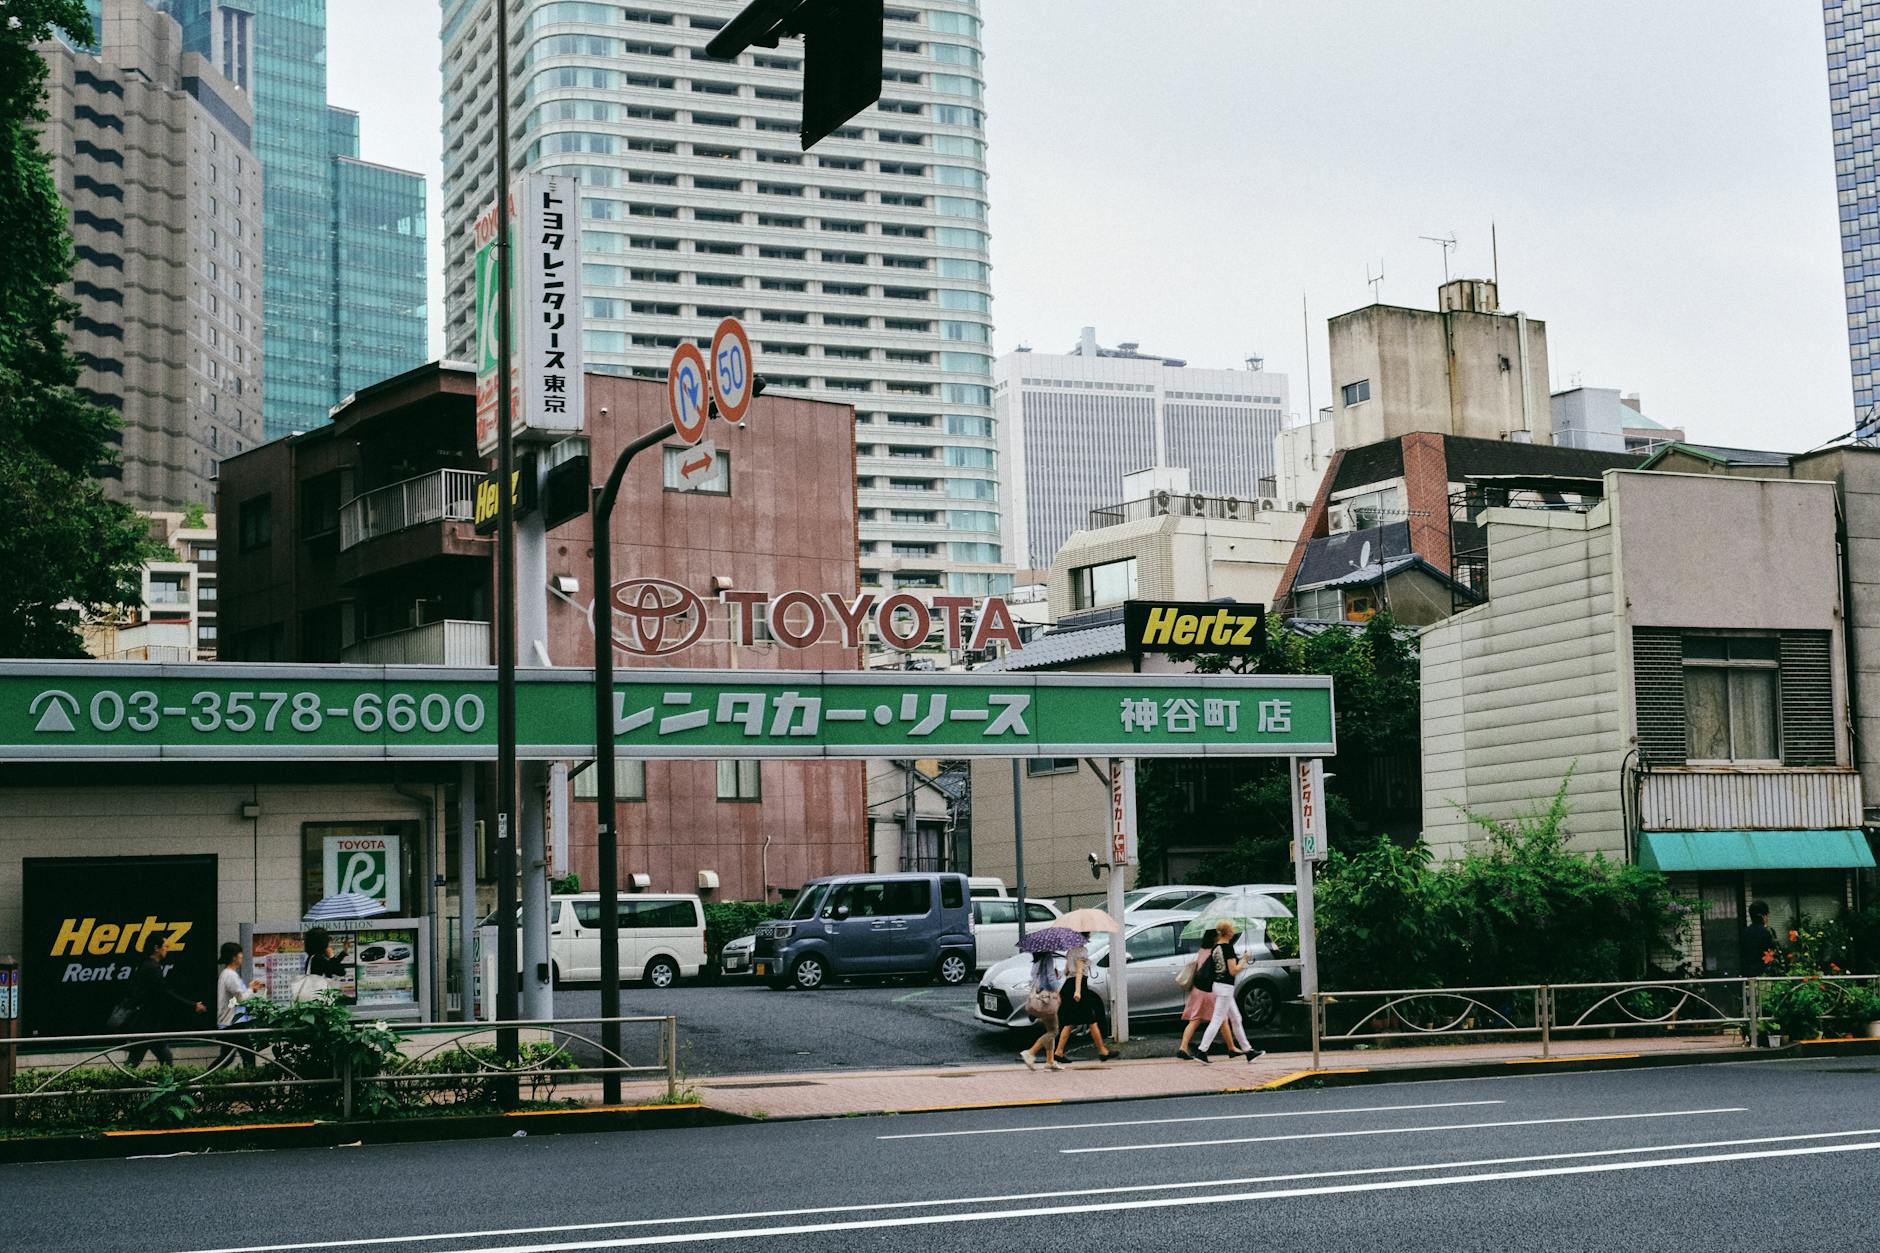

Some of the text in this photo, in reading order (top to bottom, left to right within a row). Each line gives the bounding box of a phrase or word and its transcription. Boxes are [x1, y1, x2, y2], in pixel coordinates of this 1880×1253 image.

[718, 345, 743, 396] 50
[719, 590, 1023, 651] TOYOTA
[1142, 608, 1258, 646] Hertz
[89, 689, 485, 734] 03-3578-6600
[1113, 766, 1123, 832] レンタカー
[1302, 765, 1312, 829] レンタカー
[337, 840, 386, 850] TOYOTA
[50, 916, 193, 957] Hertz
[62, 963, 116, 982] Rent
[117, 966, 132, 980] a
